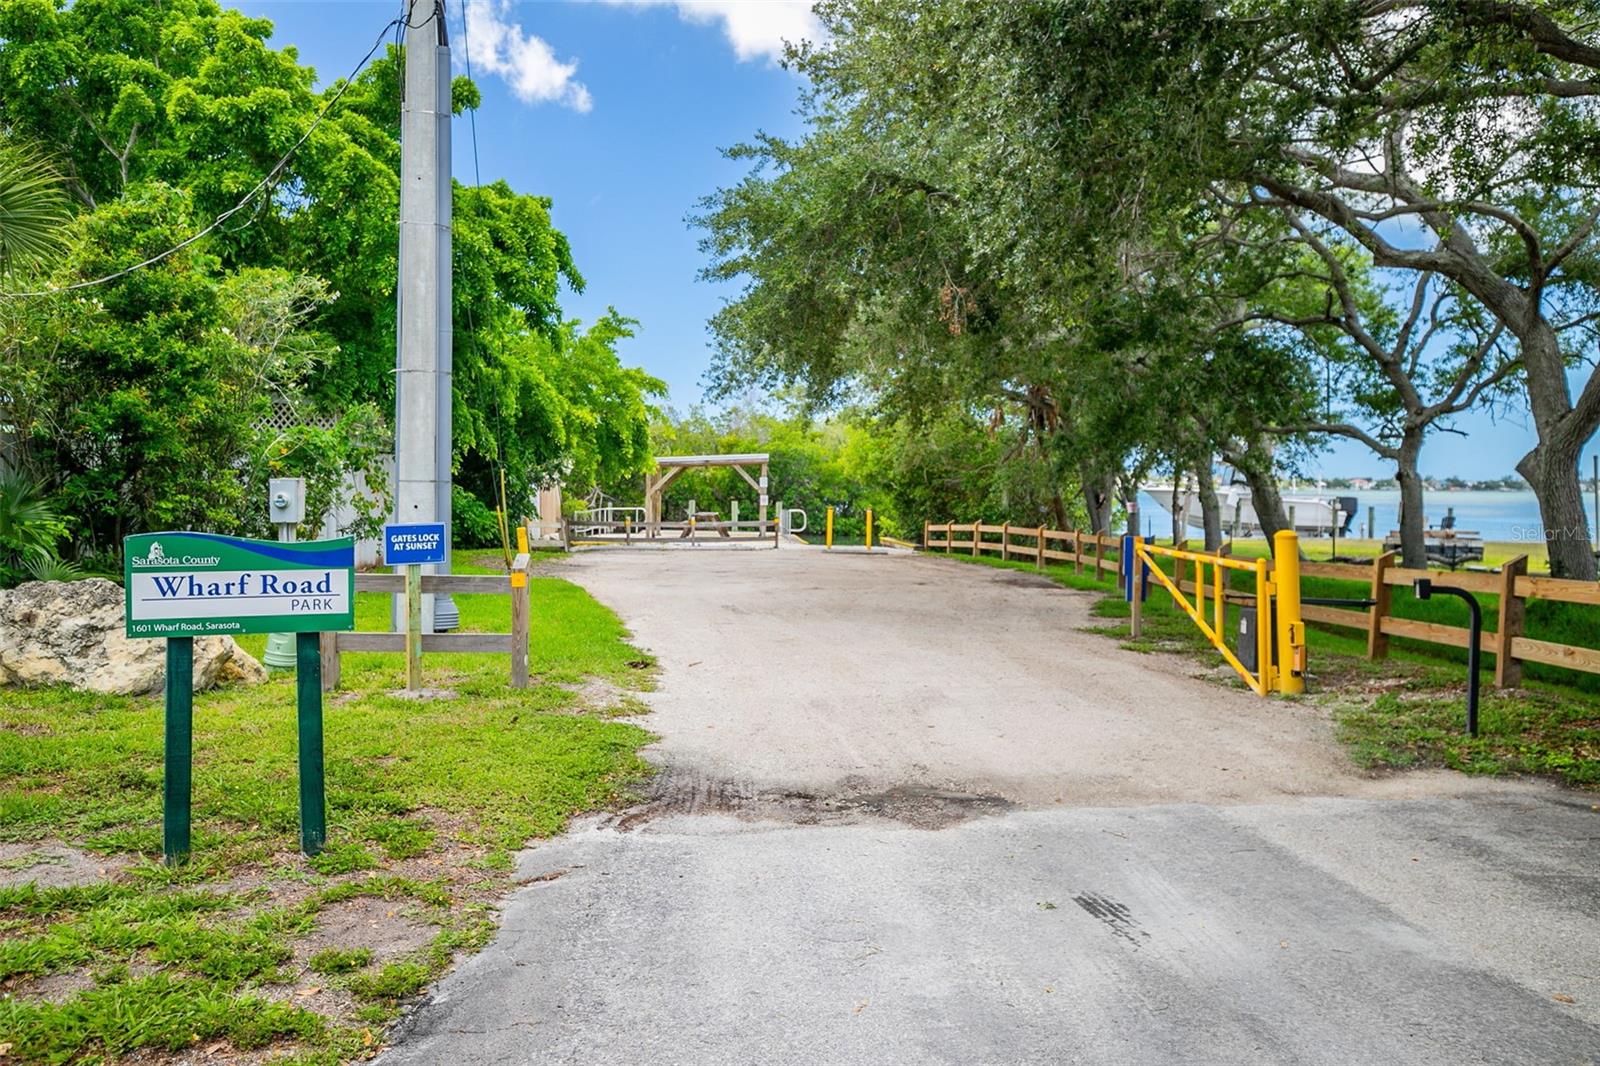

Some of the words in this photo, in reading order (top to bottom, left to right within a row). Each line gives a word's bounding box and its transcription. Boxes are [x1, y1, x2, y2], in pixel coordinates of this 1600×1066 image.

[391, 534, 417, 542] GATES
[394, 543, 404, 551] AT
[405, 542, 437, 550] SUNSET
[131, 556, 180, 566] Sarasota
[182, 555, 221, 567] County
[151, 573, 251, 598] Wharf
[260, 572, 332, 595] Road
[291, 598, 333, 611] PARK
[132, 624, 152, 633] 1601
[153, 623, 180, 632] Wharf
[181, 622, 205, 631] Road,
[205, 622, 240, 630] Sarasota
